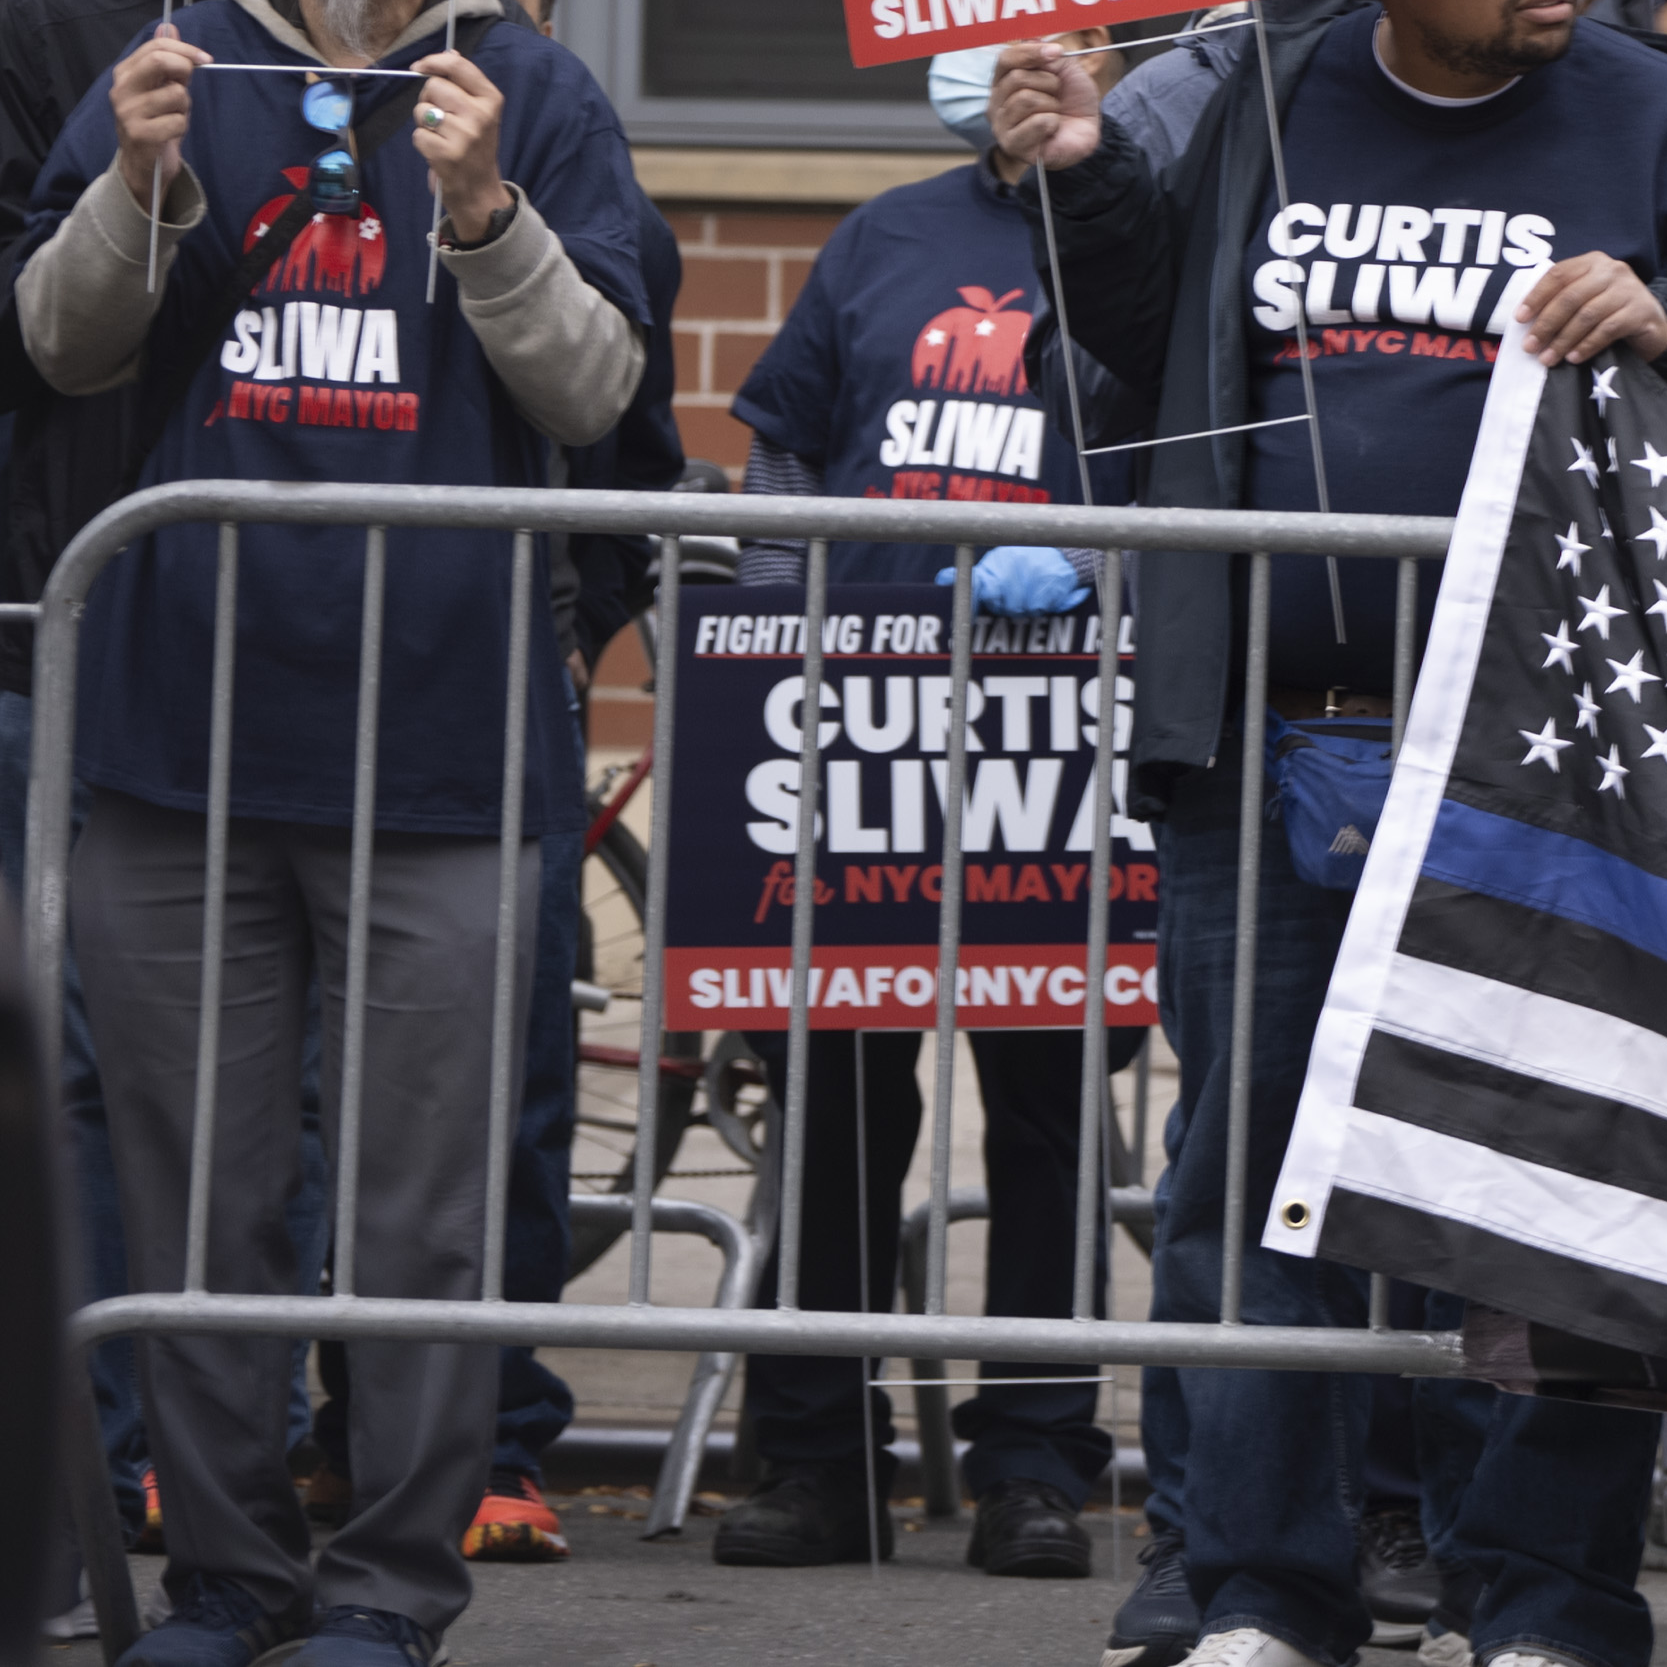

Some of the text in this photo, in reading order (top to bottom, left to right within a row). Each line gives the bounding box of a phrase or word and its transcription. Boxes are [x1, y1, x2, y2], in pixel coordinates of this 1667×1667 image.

[1268, 202, 1556, 267] CURTIS
[220, 301, 400, 383] SLIWA
[879, 399, 1046, 481] SLIWA
[764, 675, 1135, 754] CURTIS
[745, 758, 1156, 856] SLIWA
